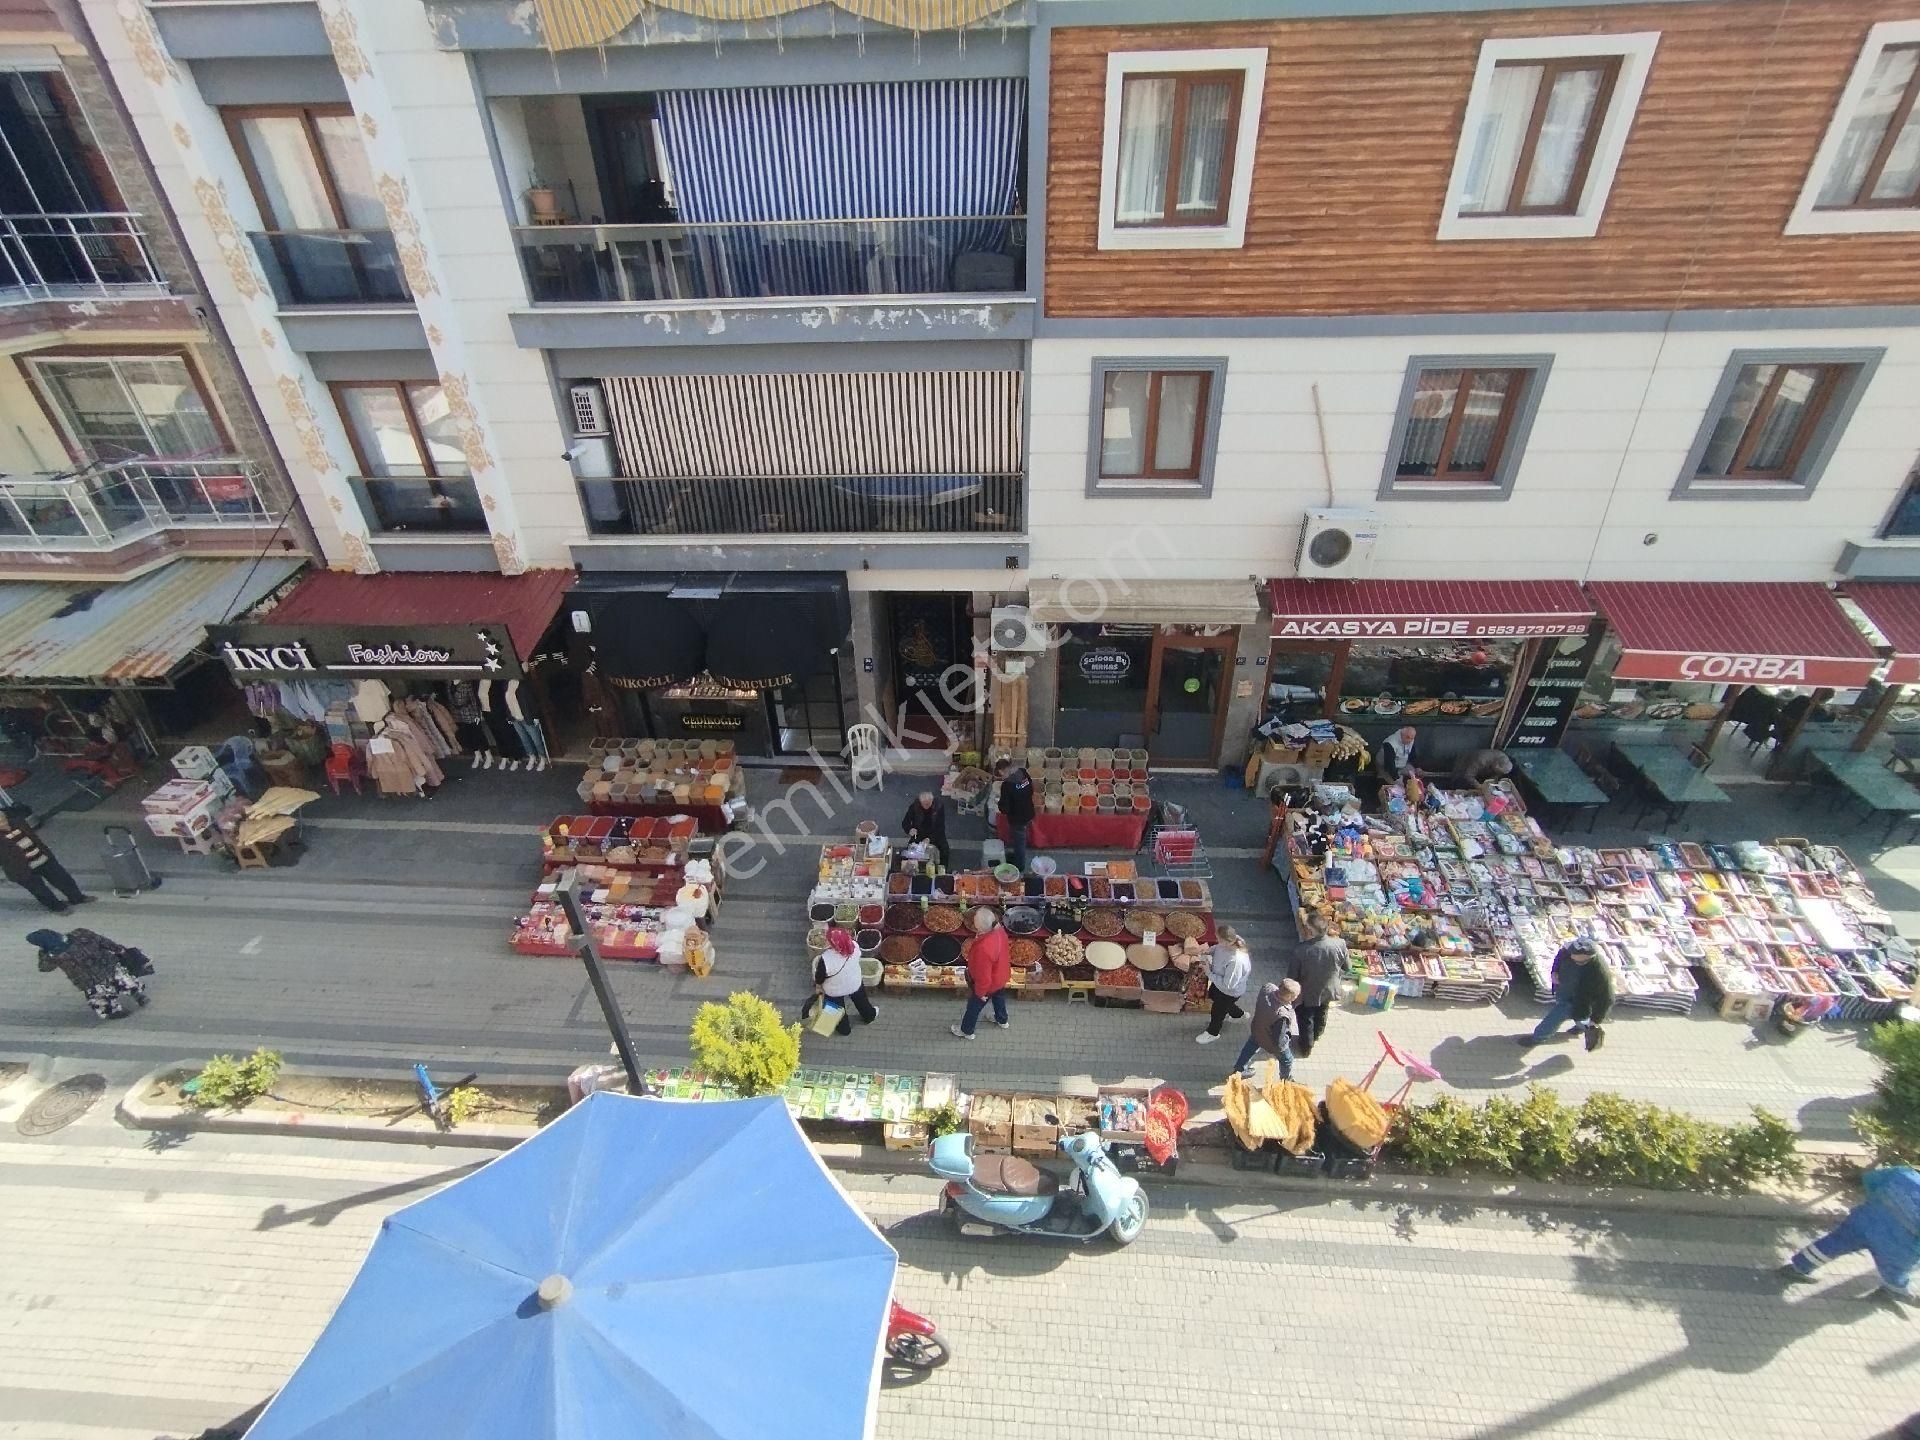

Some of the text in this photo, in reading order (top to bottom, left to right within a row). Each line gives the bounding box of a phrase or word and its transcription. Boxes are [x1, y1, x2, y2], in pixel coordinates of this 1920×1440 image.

[1281, 621, 1398, 635] AKASYA
[1403, 618, 1470, 634] PİDE
[1476, 626, 1486, 635] 0
[1487, 626, 1515, 635] 553
[1516, 625, 1545, 634] 273
[1546, 625, 1566, 633] 07
[223, 641, 449, 671] İNCİ Fashion
[1680, 655, 1806, 680] ÇORBA
